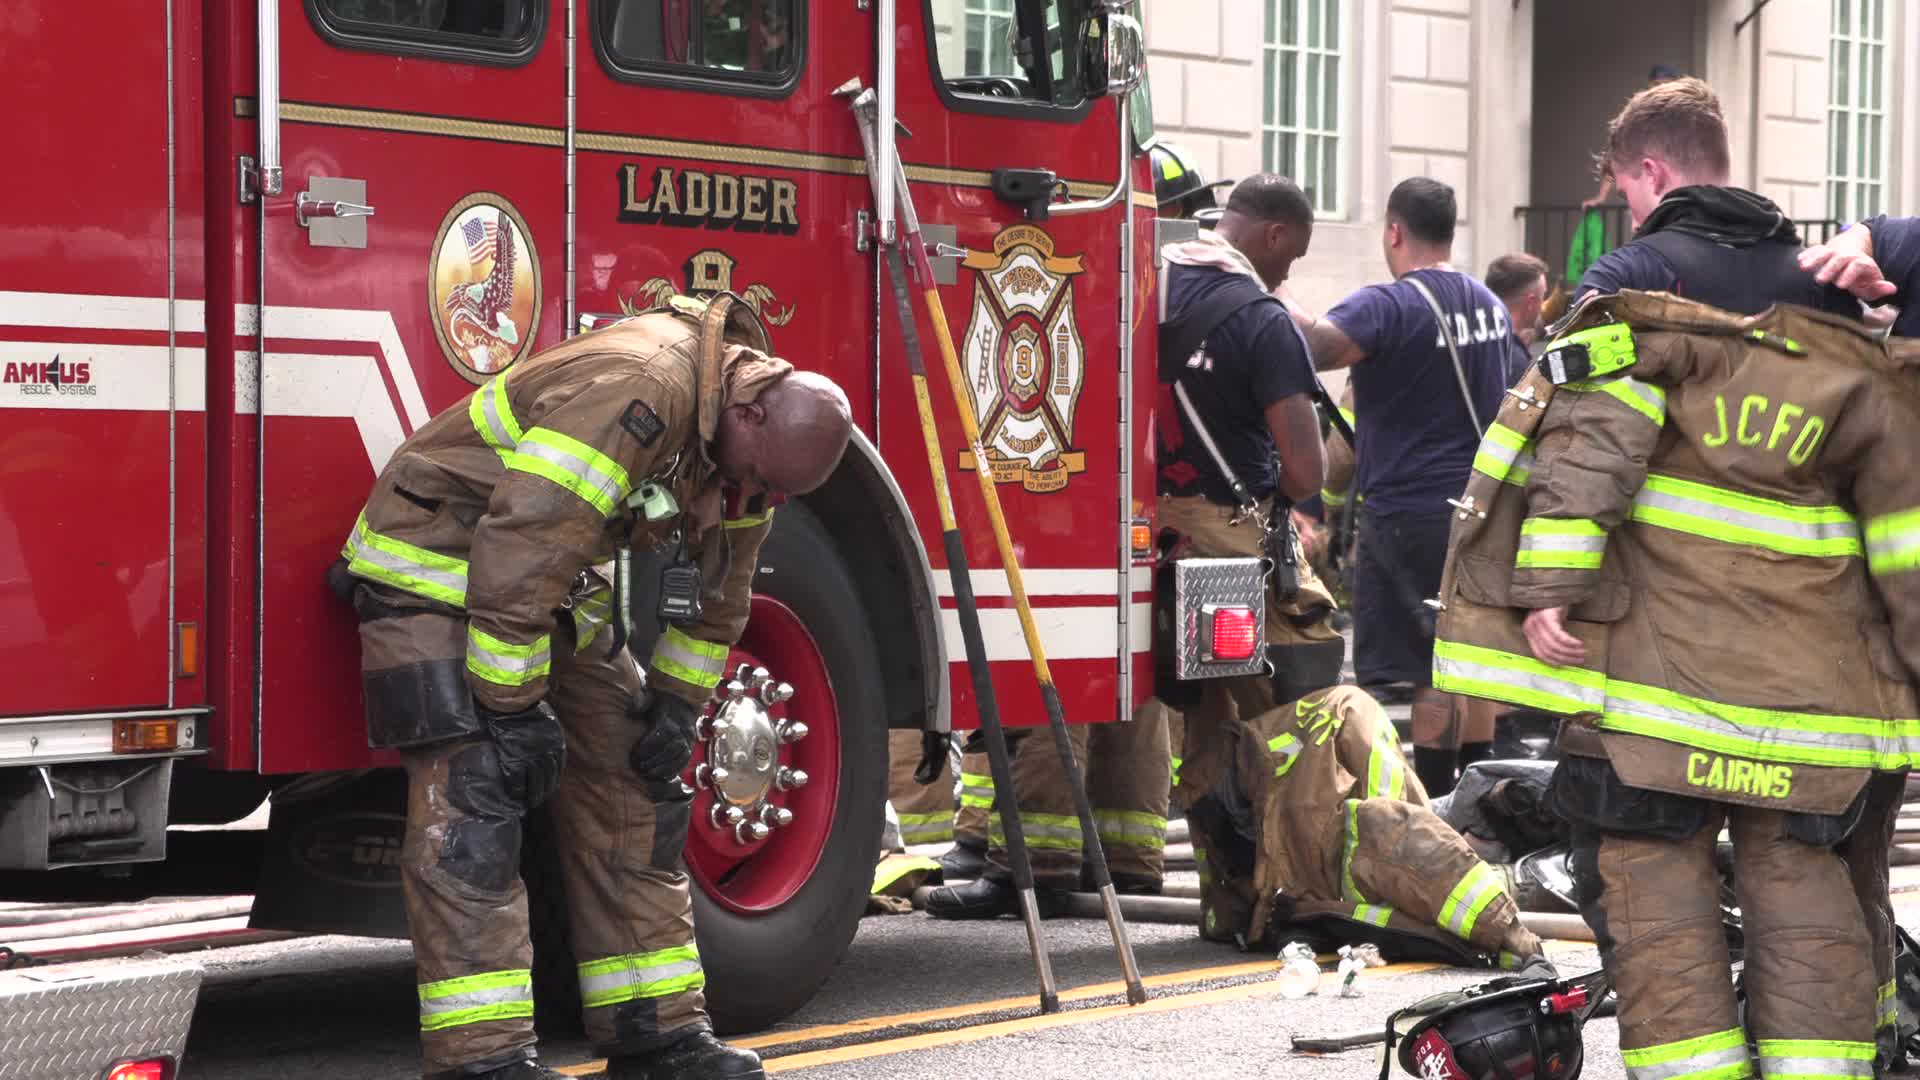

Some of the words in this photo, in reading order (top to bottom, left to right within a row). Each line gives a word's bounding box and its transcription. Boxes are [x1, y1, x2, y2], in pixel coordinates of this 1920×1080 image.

[618, 164, 800, 232] LADDER
[999, 265, 1051, 295] JERSEY
[3, 361, 91, 384] AMKUS
[1015, 344, 1034, 380] 9
[20, 384, 52, 395] RESCUE
[59, 384, 96, 395] SYSTEMS
[1000, 425, 1048, 454] LADDER
[1703, 393, 1826, 466] JCFD
[1686, 752, 1793, 799] CAIRNS
